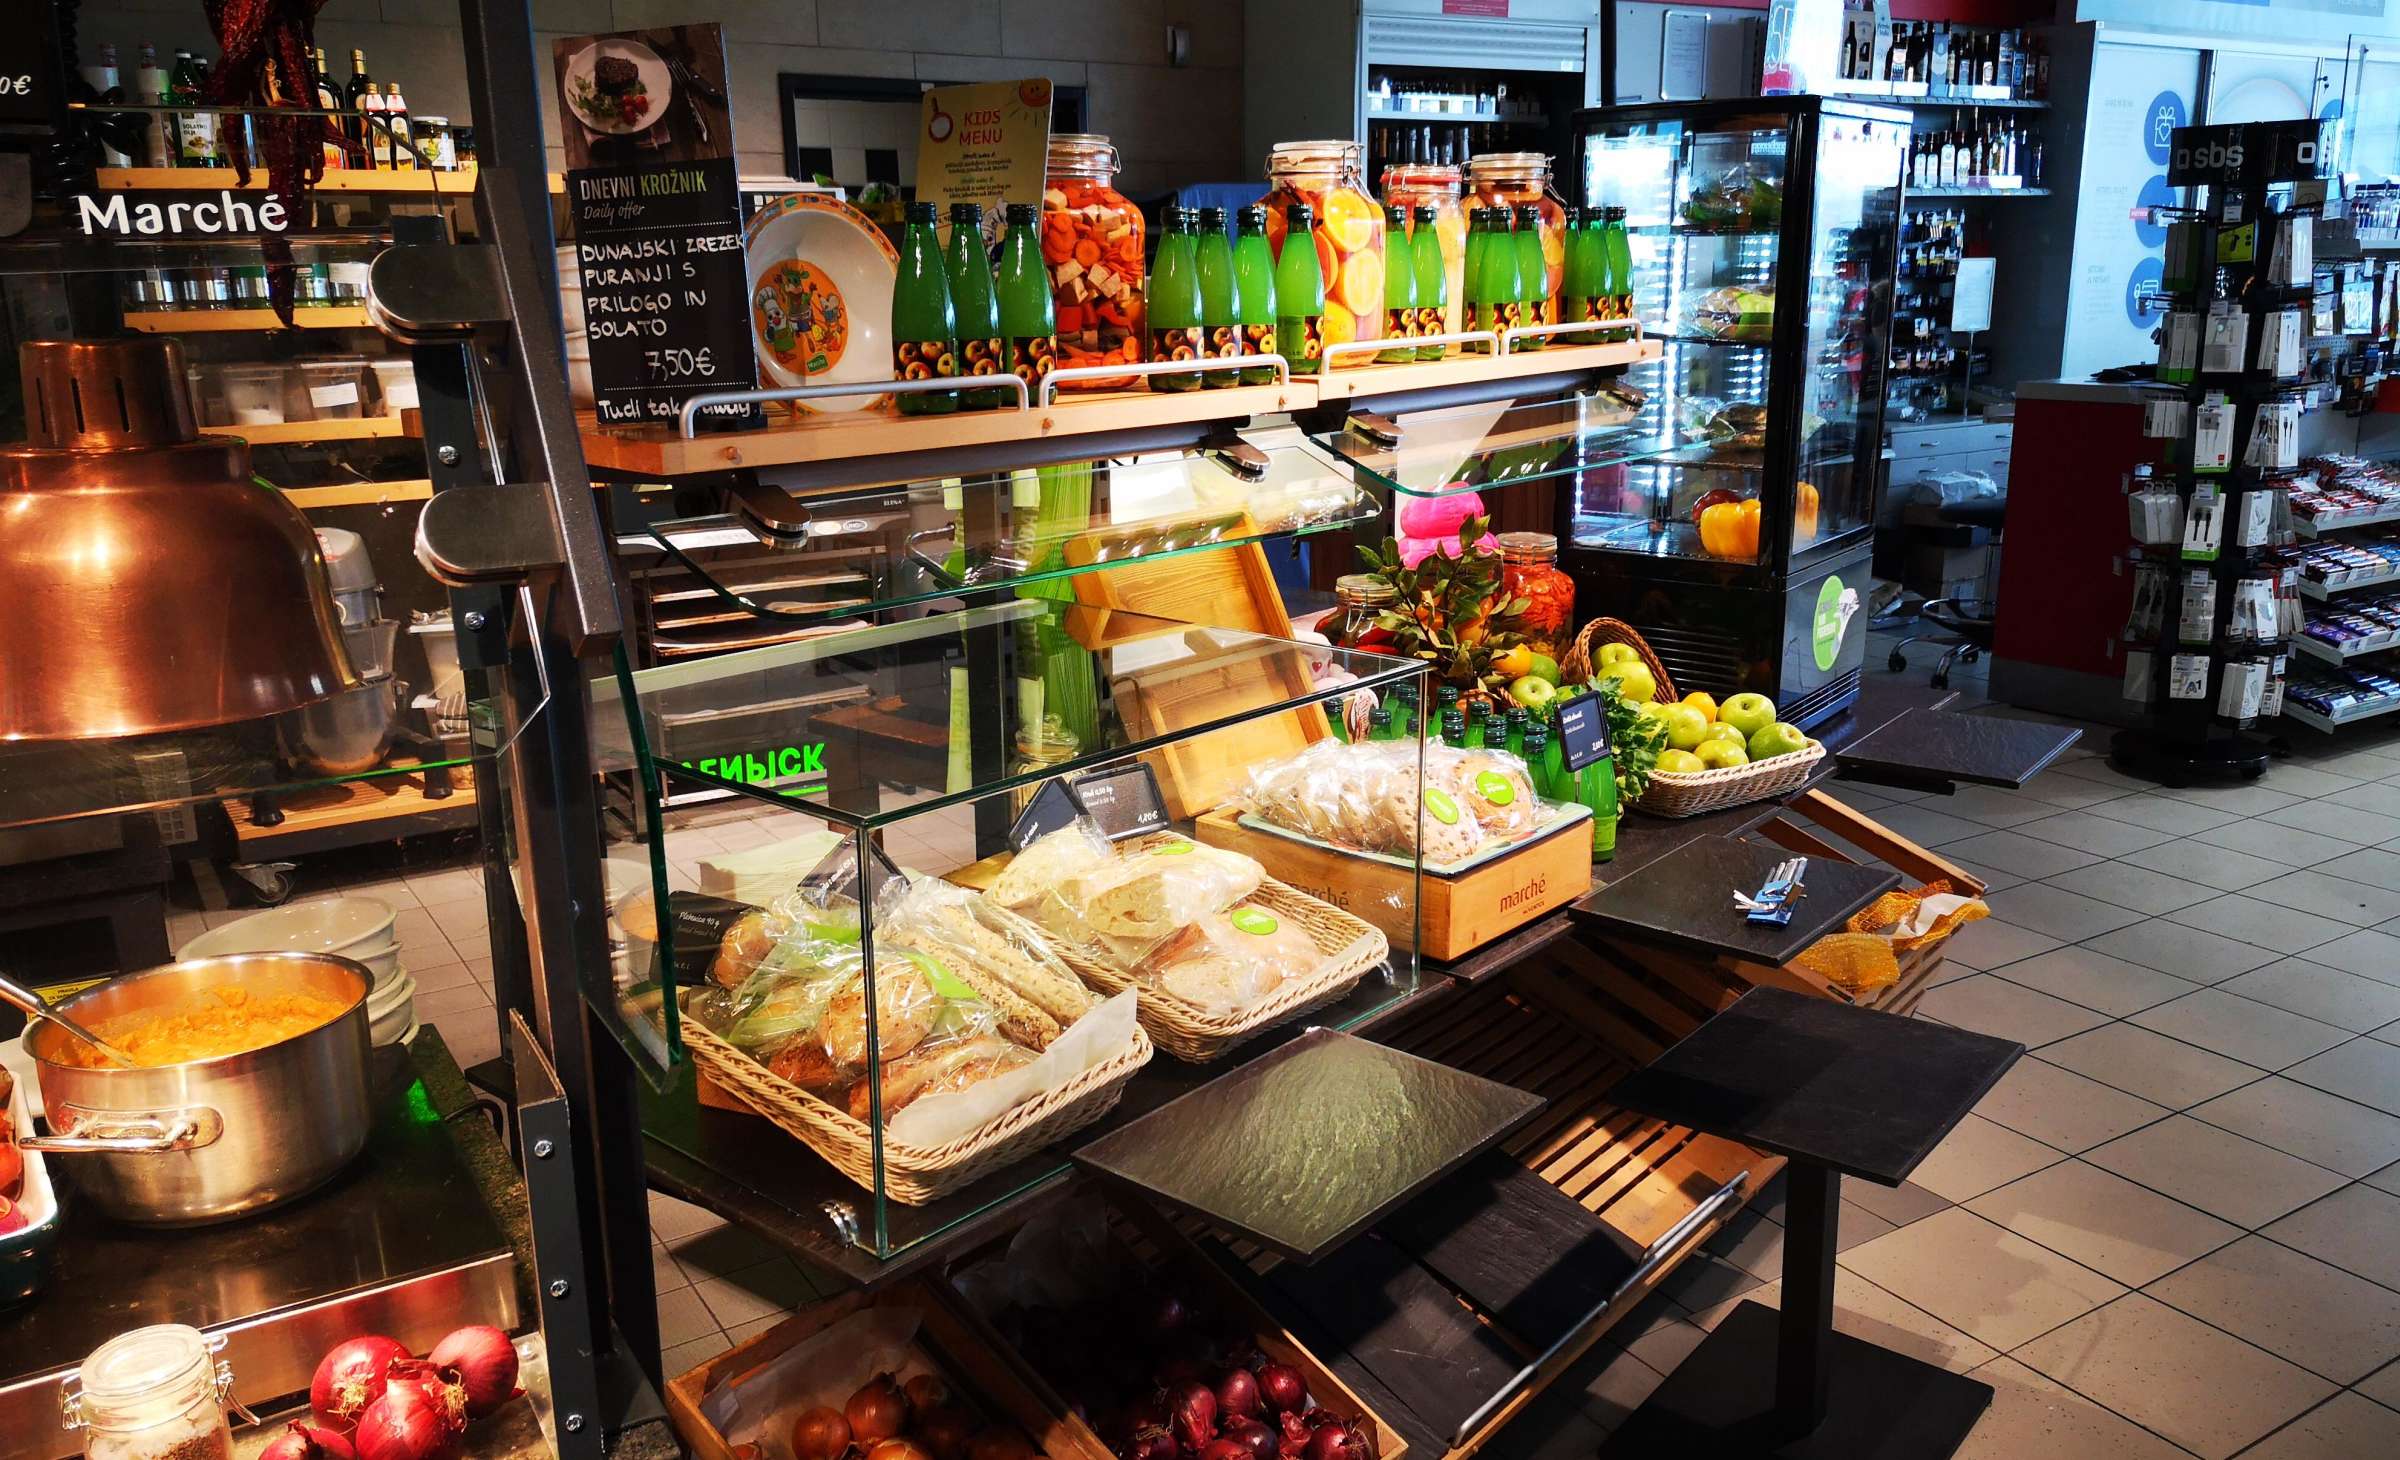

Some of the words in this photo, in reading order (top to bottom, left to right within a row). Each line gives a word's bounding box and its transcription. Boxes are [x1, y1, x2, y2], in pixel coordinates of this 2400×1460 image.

[963, 109, 1001, 127] KIDS
[959, 128, 1003, 146] MENU
[2193, 140, 2245, 169] sbs
[580, 175, 636, 201] DNEVNI
[640, 168, 707, 196] KROŽNIK
[77, 189, 289, 236] Marché
[583, 202, 616, 226] Daily
[618, 200, 645, 220] offer
[581, 238, 677, 262] DUNAJSKI
[685, 233, 744, 254] ZREZEK
[584, 262, 672, 288] PURANJI
[682, 261, 697, 278] S
[587, 292, 672, 315] PRILOGO
[684, 289, 707, 307] IN
[589, 318, 667, 340] SOLATO
[644, 346, 716, 381] 7,50€
[1500, 872, 1546, 913] marché
